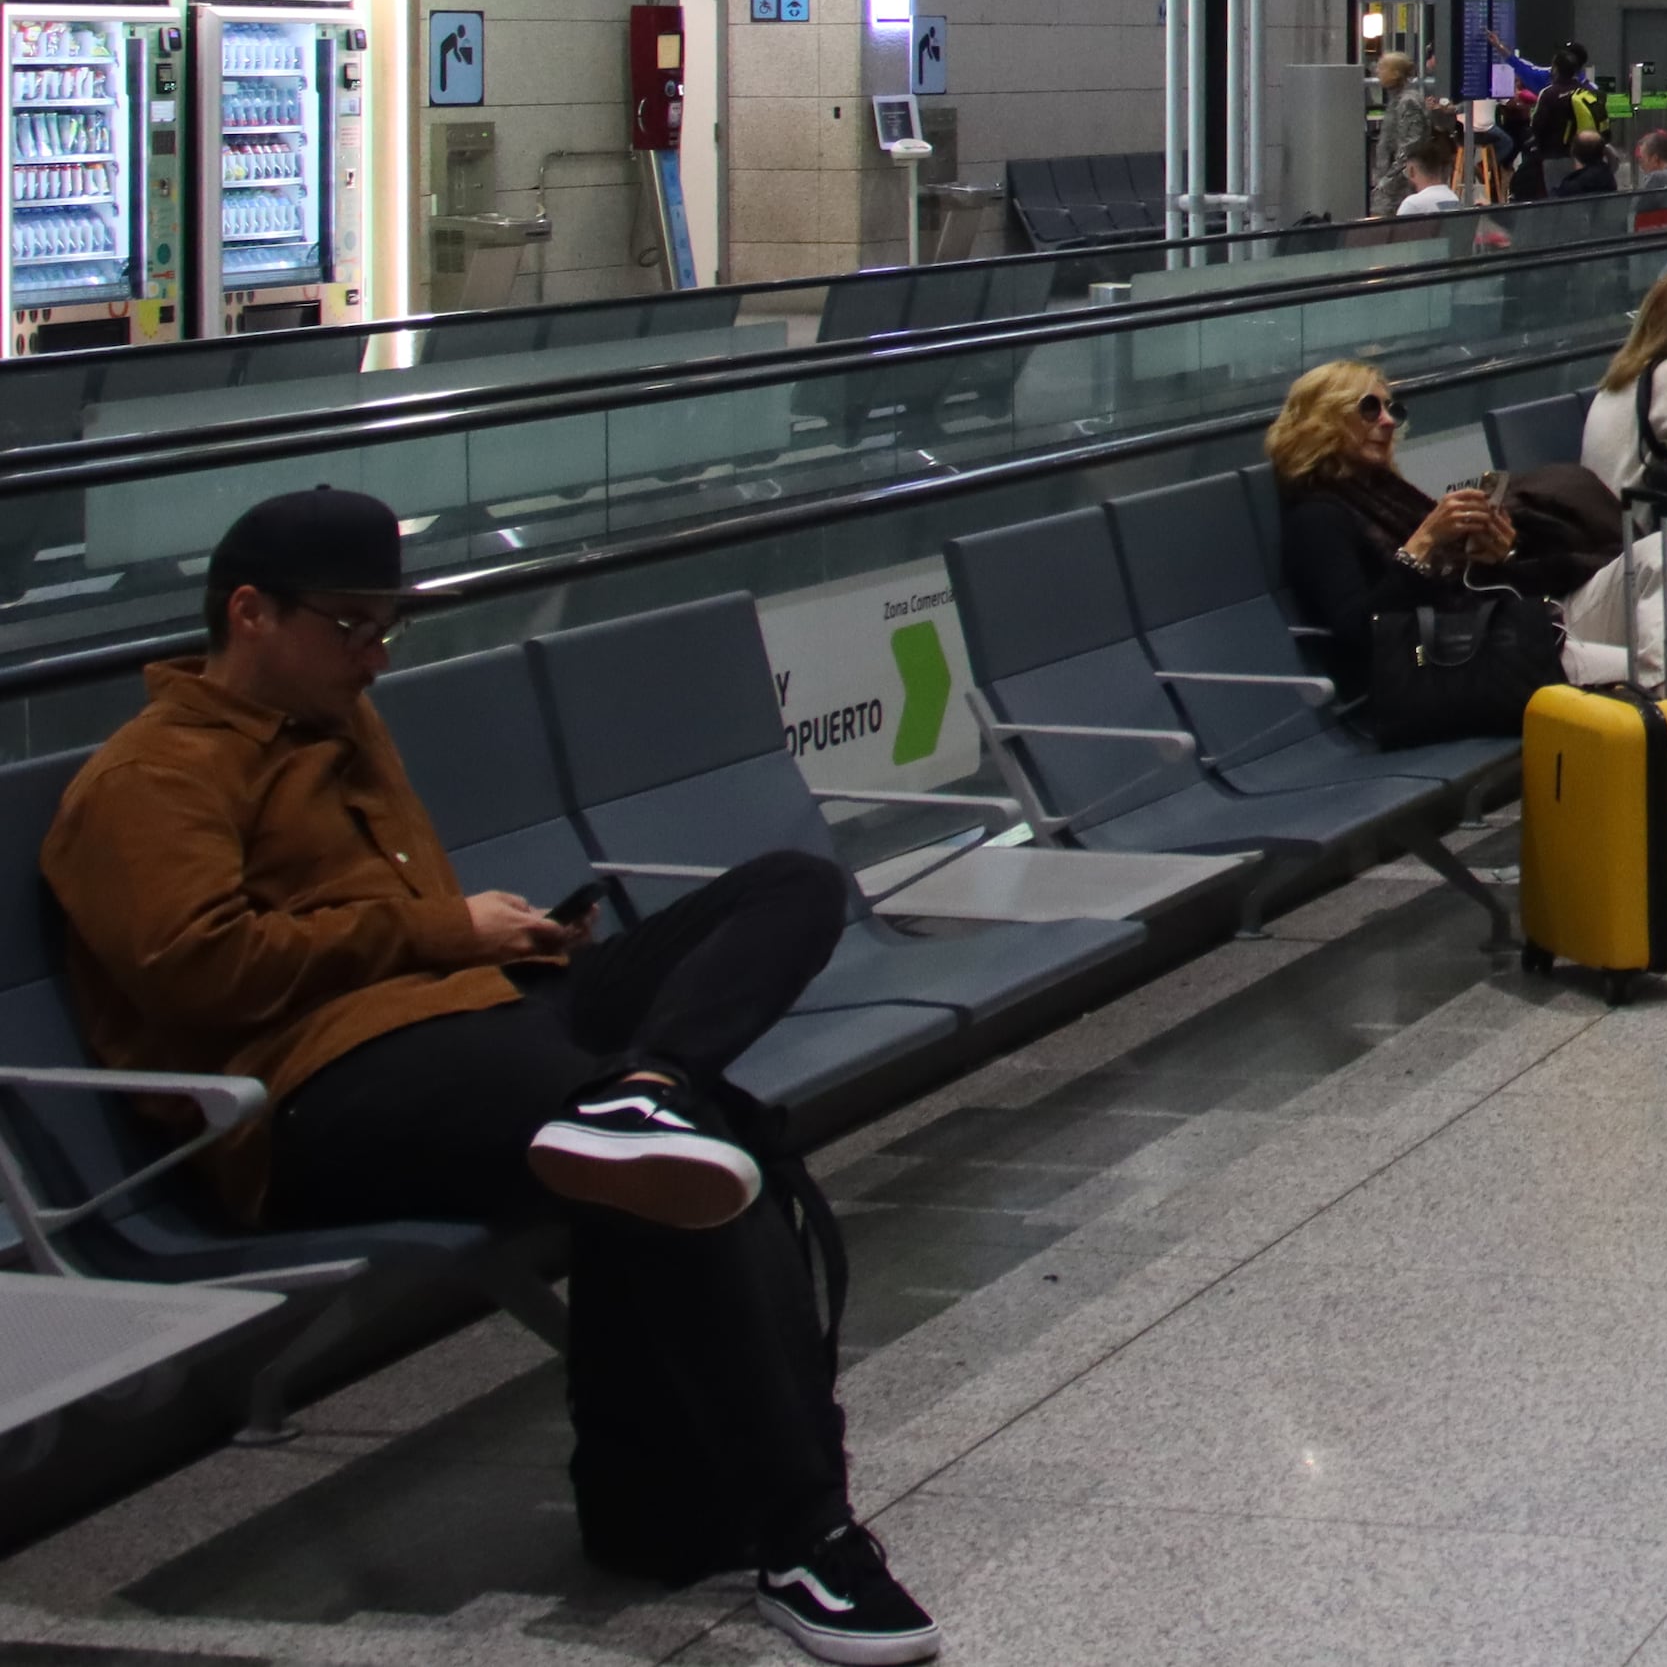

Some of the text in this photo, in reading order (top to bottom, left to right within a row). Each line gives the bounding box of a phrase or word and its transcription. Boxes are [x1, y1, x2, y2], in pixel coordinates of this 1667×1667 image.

[884, 586, 955, 621] Zona Comercia
[775, 670, 791, 707] Y
[784, 698, 883, 758] OPUERTO
